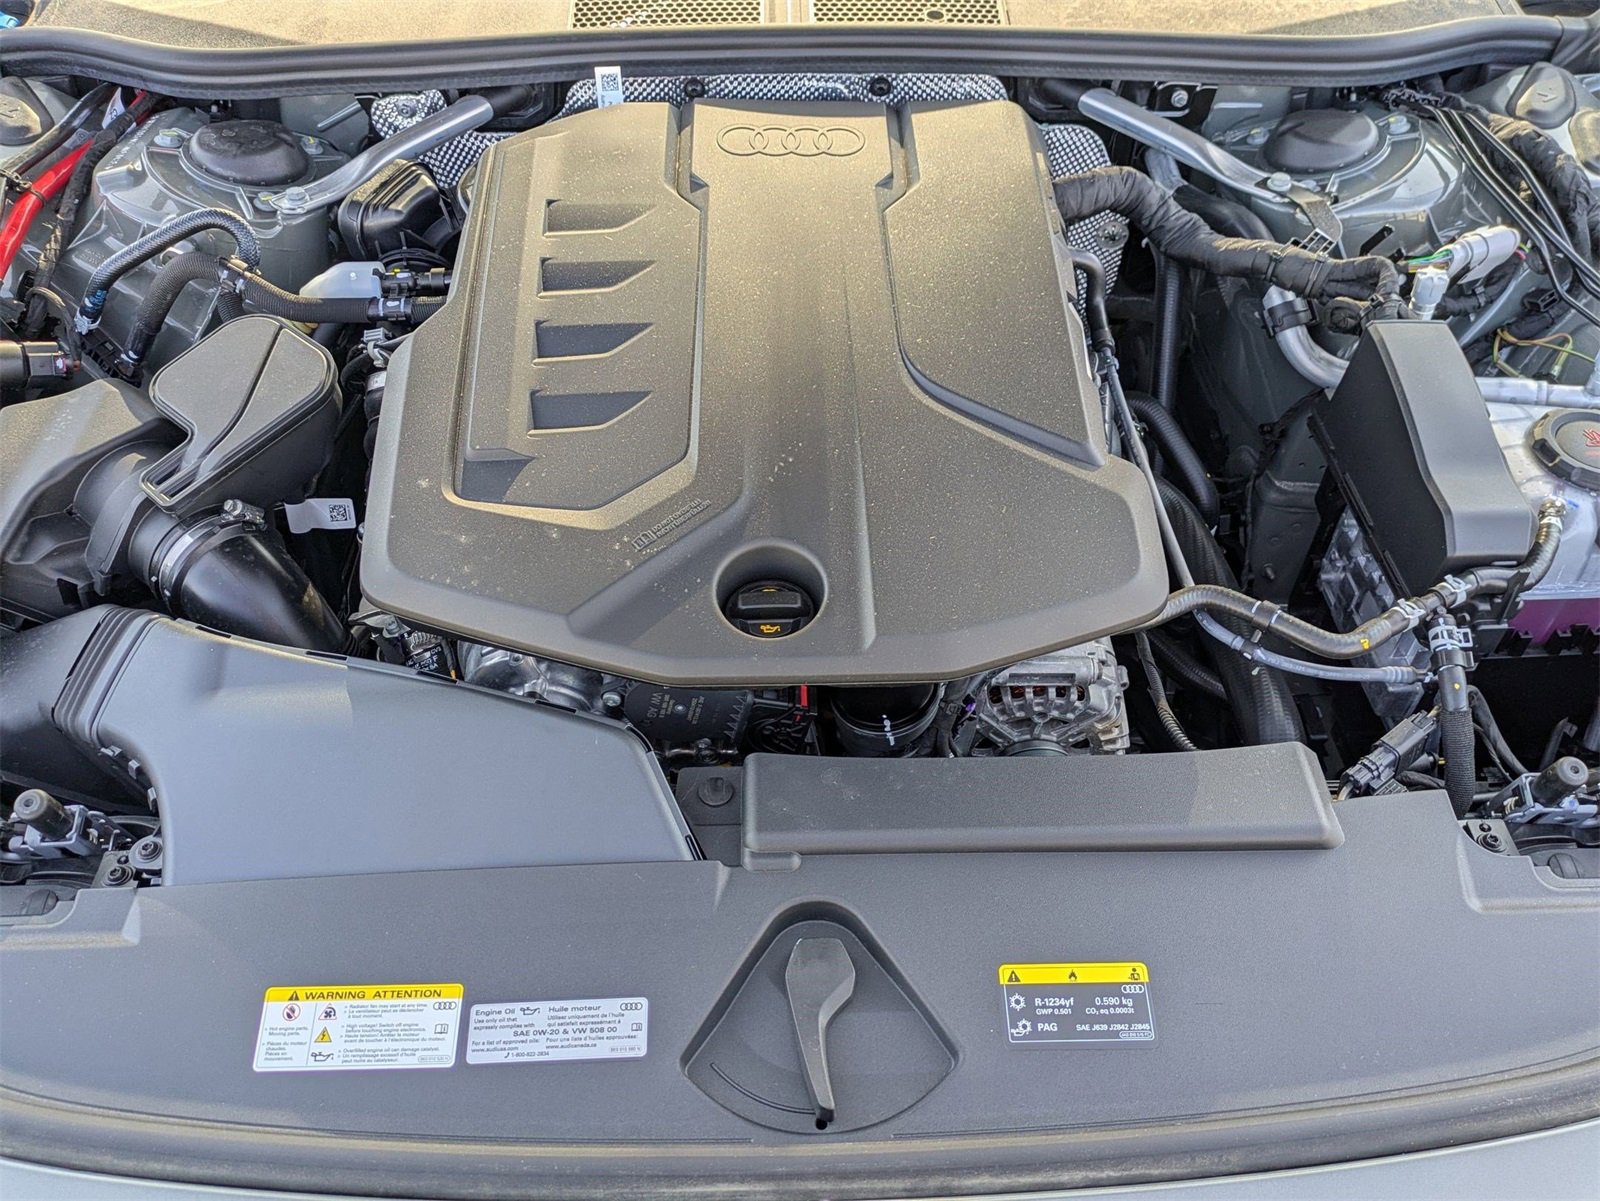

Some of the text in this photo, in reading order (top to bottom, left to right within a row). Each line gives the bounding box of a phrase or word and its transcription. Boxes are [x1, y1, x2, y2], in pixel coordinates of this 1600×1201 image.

[646, 692, 662, 718] VW AG
[304, 989, 442, 1000] WARNING ATTENTION
[1034, 997, 1133, 1007] R-1234yf 0.590 kg
[1037, 1023, 1058, 1032] PAG
